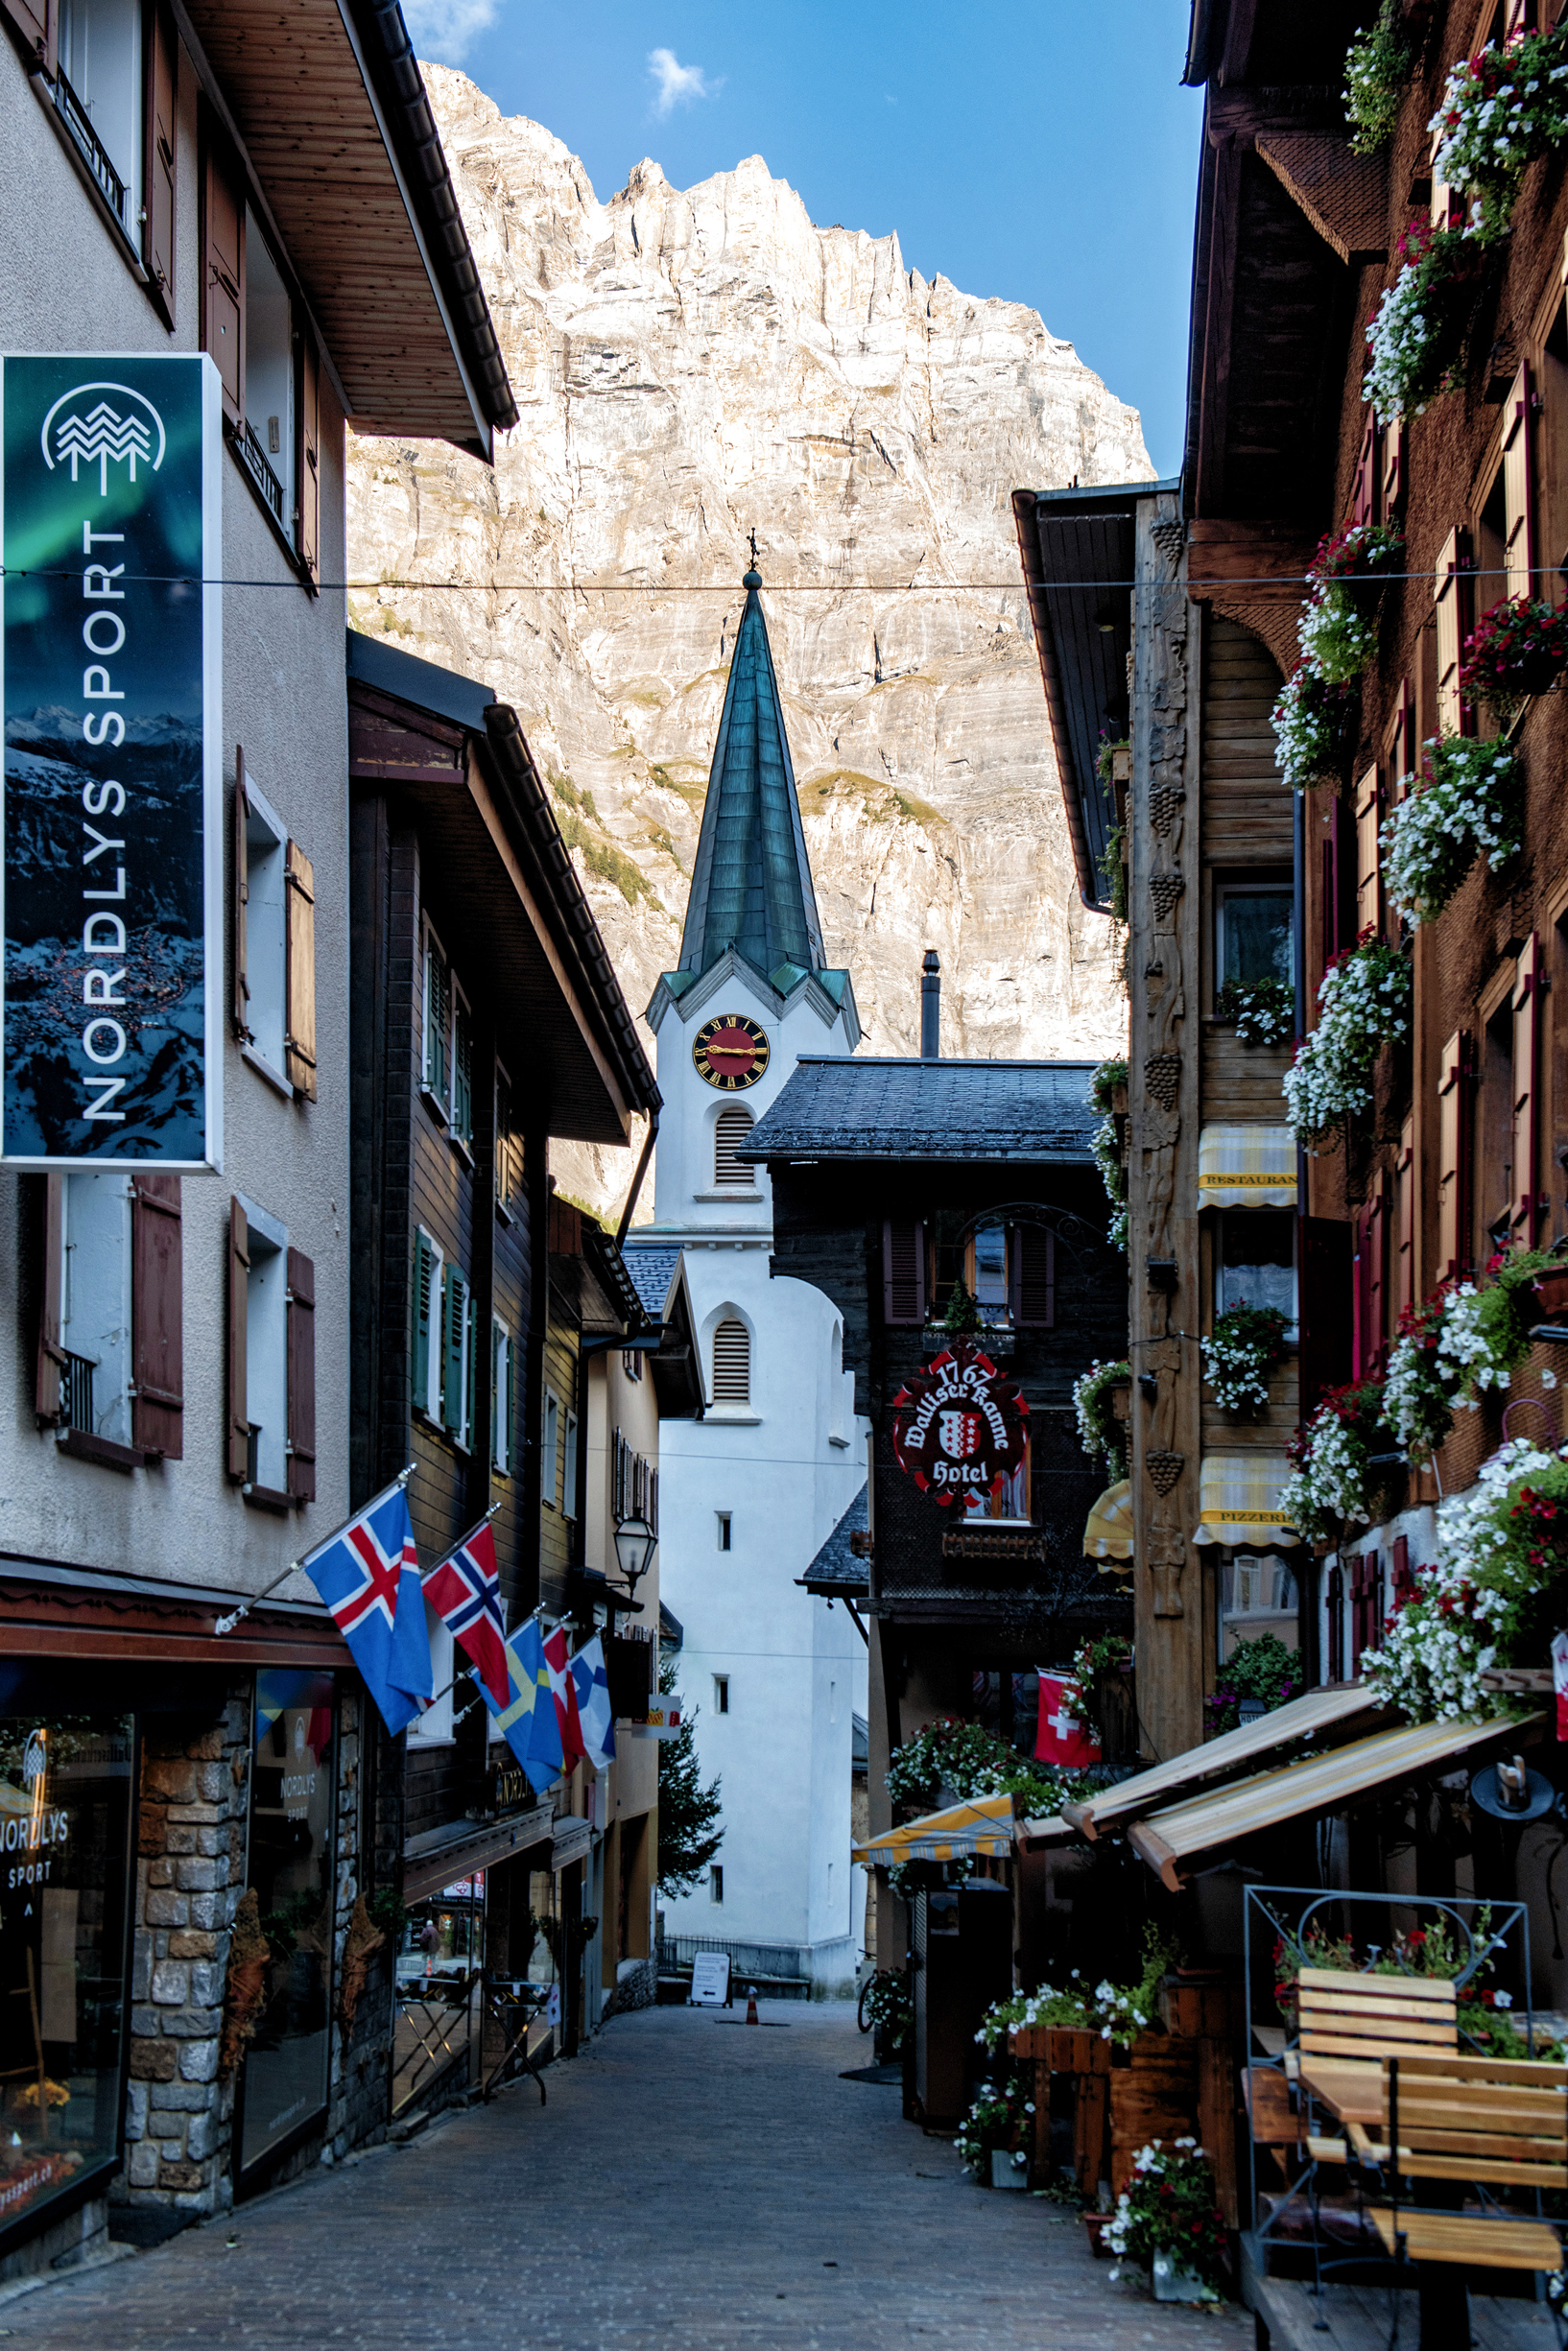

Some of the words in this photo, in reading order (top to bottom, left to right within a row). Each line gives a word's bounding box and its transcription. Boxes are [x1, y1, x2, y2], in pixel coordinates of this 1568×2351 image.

[83, 519, 127, 748] SPORT
[83, 779, 127, 1122] NORDLYS
[1206, 1176, 1297, 1184] RESTAURAN
[936, 1360, 993, 1388] 1767
[904, 1383, 969, 1449] Walliser
[933, 1460, 988, 1487] Hotel
[280, 1773, 316, 1799] NORDLYS
[287, 1806, 307, 1823] SPORT
[8, 1860, 53, 1889] SPORT
